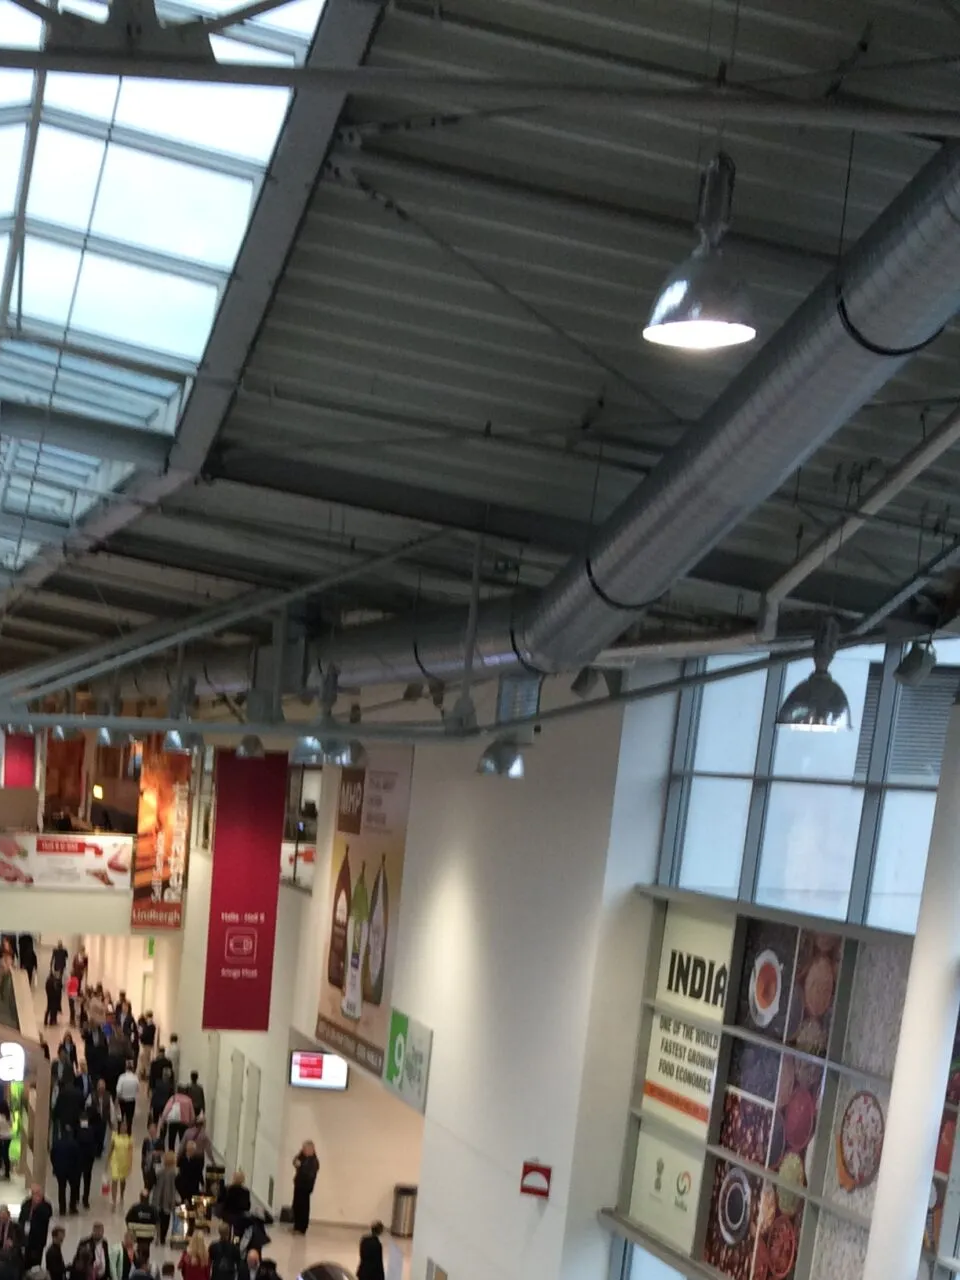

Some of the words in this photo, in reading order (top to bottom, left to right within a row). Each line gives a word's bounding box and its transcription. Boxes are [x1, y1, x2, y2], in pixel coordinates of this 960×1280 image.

[132, 910, 180, 925] Lindbergh
[667, 949, 727, 1008] INDIA
[392, 1032, 404, 1085] 9
[660, 1036, 687, 1062] FASTEST
[687, 1047, 717, 1074] GROWIN
